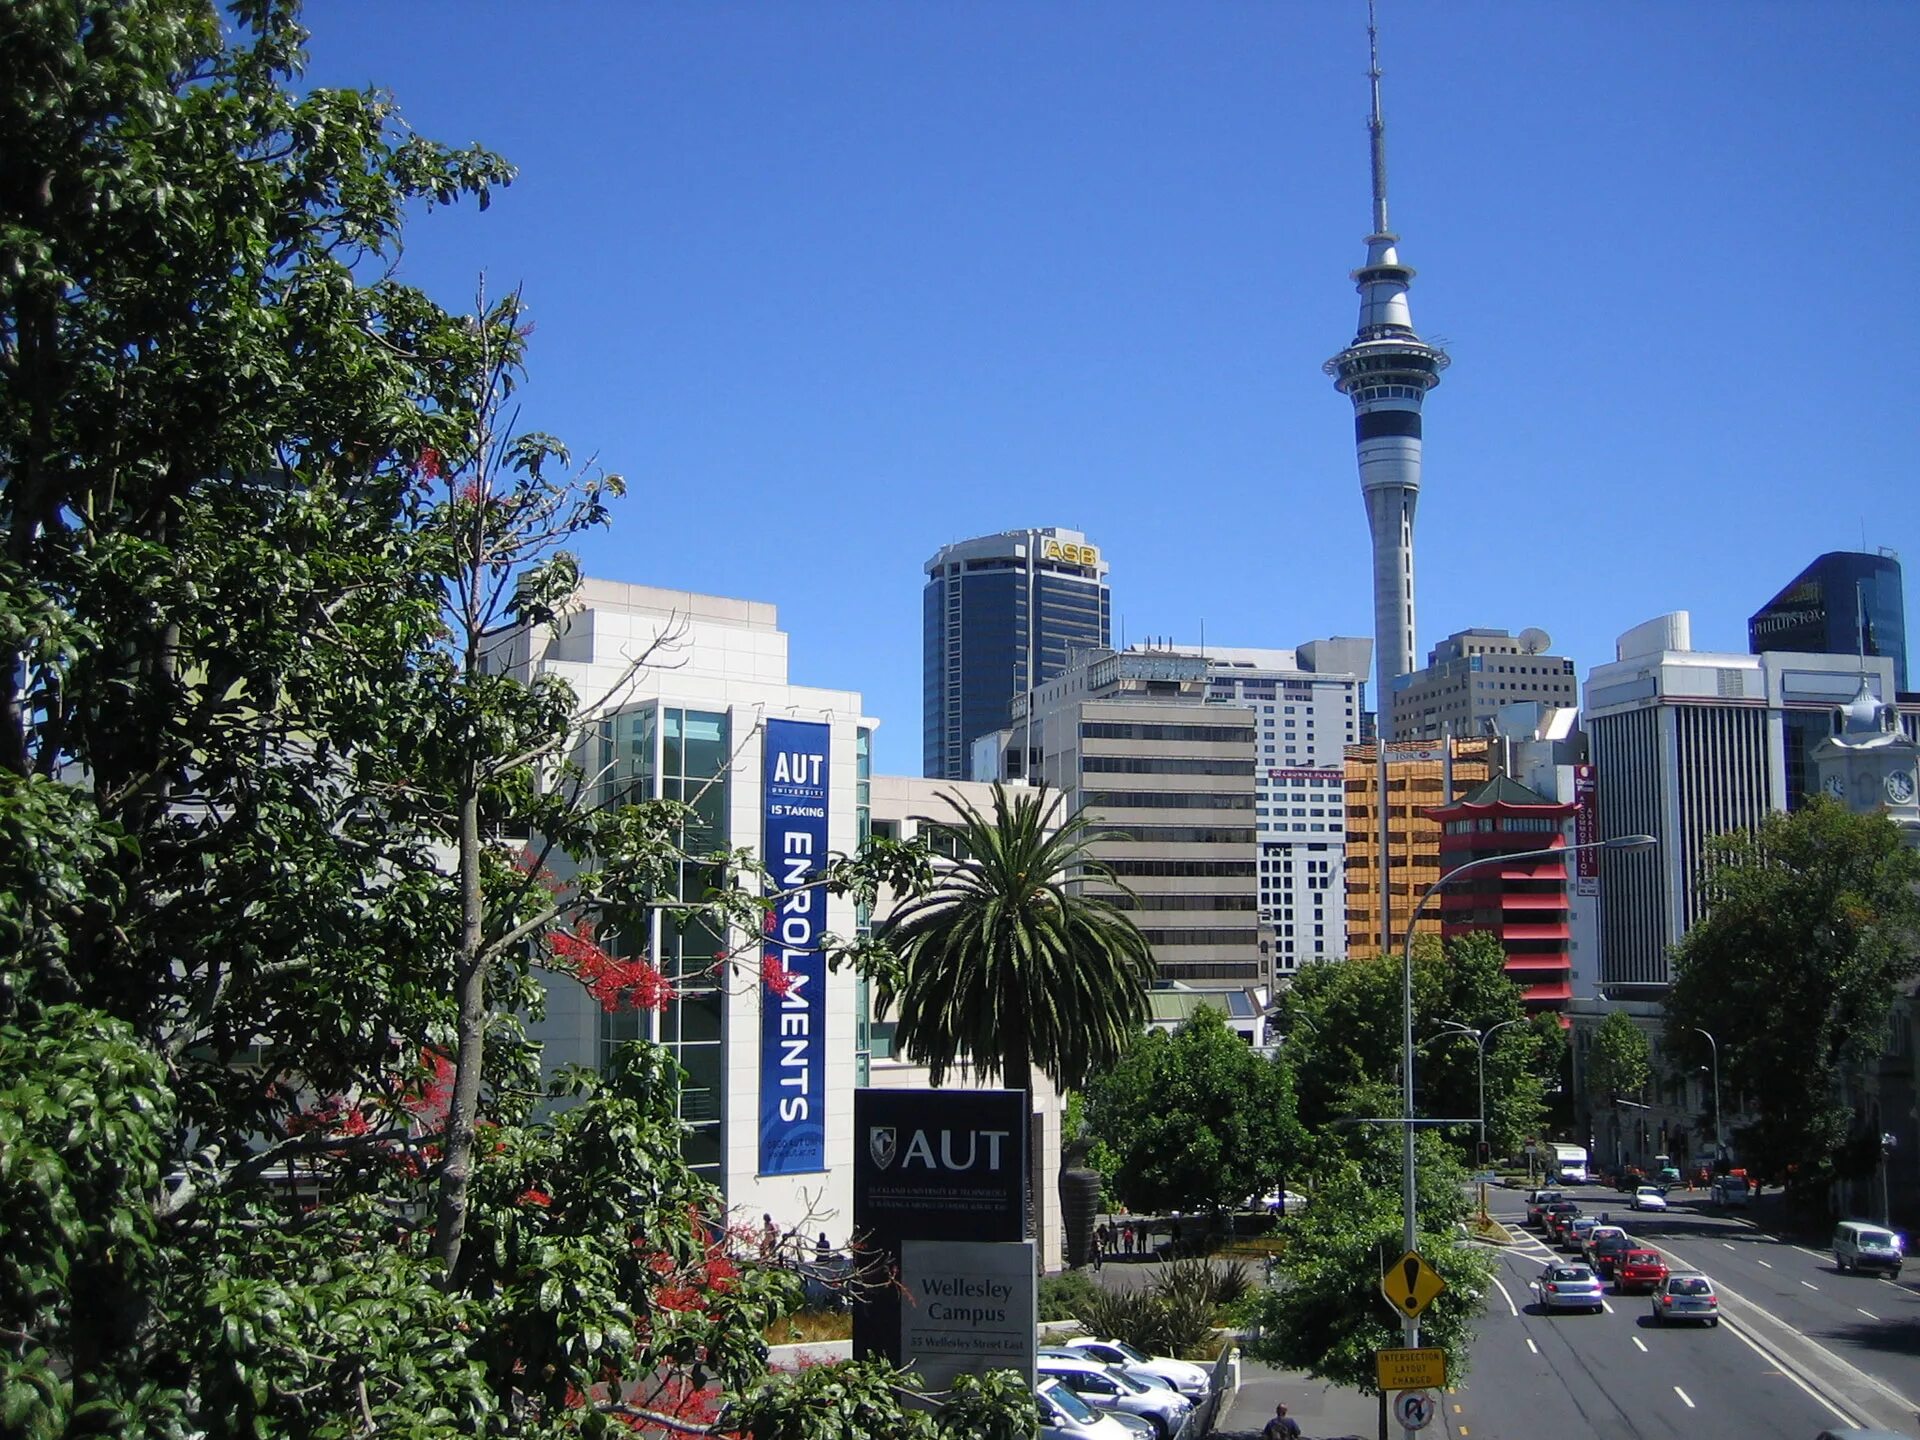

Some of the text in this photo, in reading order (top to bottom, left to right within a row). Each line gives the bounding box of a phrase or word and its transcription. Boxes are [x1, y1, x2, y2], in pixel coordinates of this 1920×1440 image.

[1044, 540, 1096, 566] ASB
[773, 751, 824, 785] AUT
[771, 787, 824, 797] UNIVERSITY
[771, 804, 825, 818] IS TAKING
[779, 831, 812, 1122] ENROLMENTS
[901, 1129, 1010, 1170] AUT
[921, 1278, 1013, 1303] Wellesley
[928, 1302, 1006, 1327] Campus
[925, 1336, 970, 1350] Wellesley
[973, 1337, 1001, 1350] Street
[1004, 1339, 1023, 1350] East
[1381, 1352, 1440, 1362] INTERSECTION
[1395, 1364, 1426, 1373] LAYOUT
[1392, 1375, 1432, 1385] CHANGED
